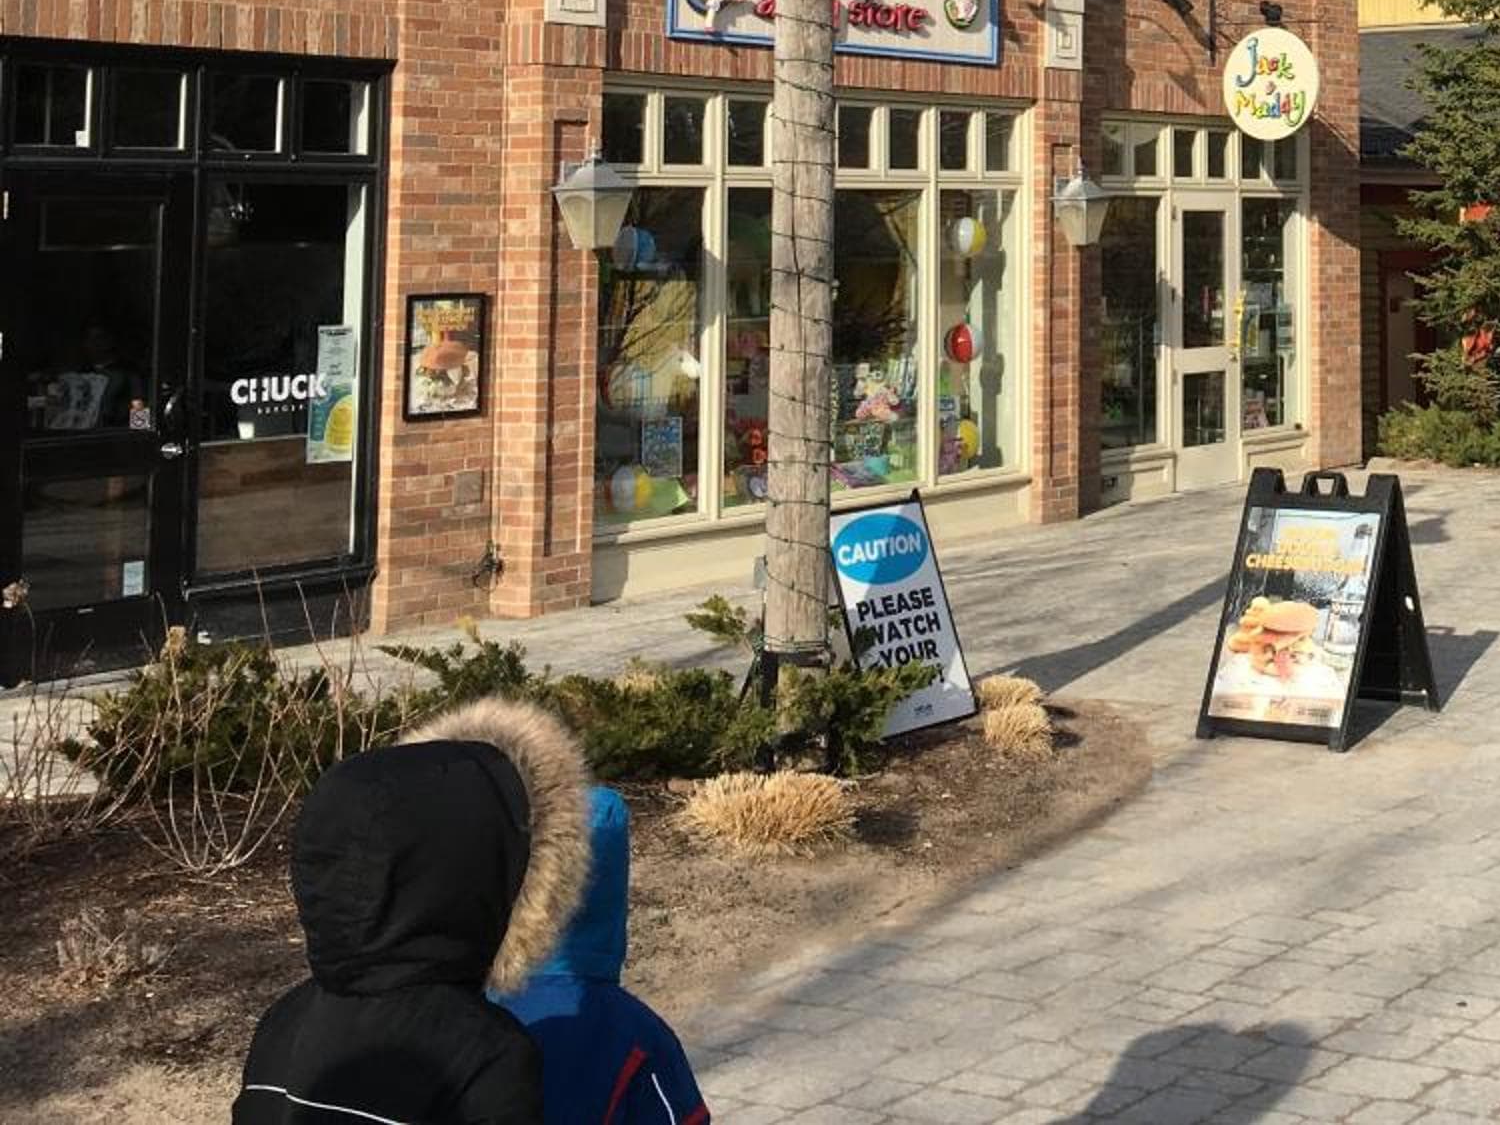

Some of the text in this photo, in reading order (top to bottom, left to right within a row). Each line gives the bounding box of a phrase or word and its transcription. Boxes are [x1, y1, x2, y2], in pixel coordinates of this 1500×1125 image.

[1235, 37, 1295, 87] Jack
[1234, 90, 1306, 127] Maddy
[230, 374, 327, 404] CHUCK
[838, 532, 922, 565] CAUTION
[856, 587, 935, 622] PLEASE
[878, 639, 939, 669] YOUR
